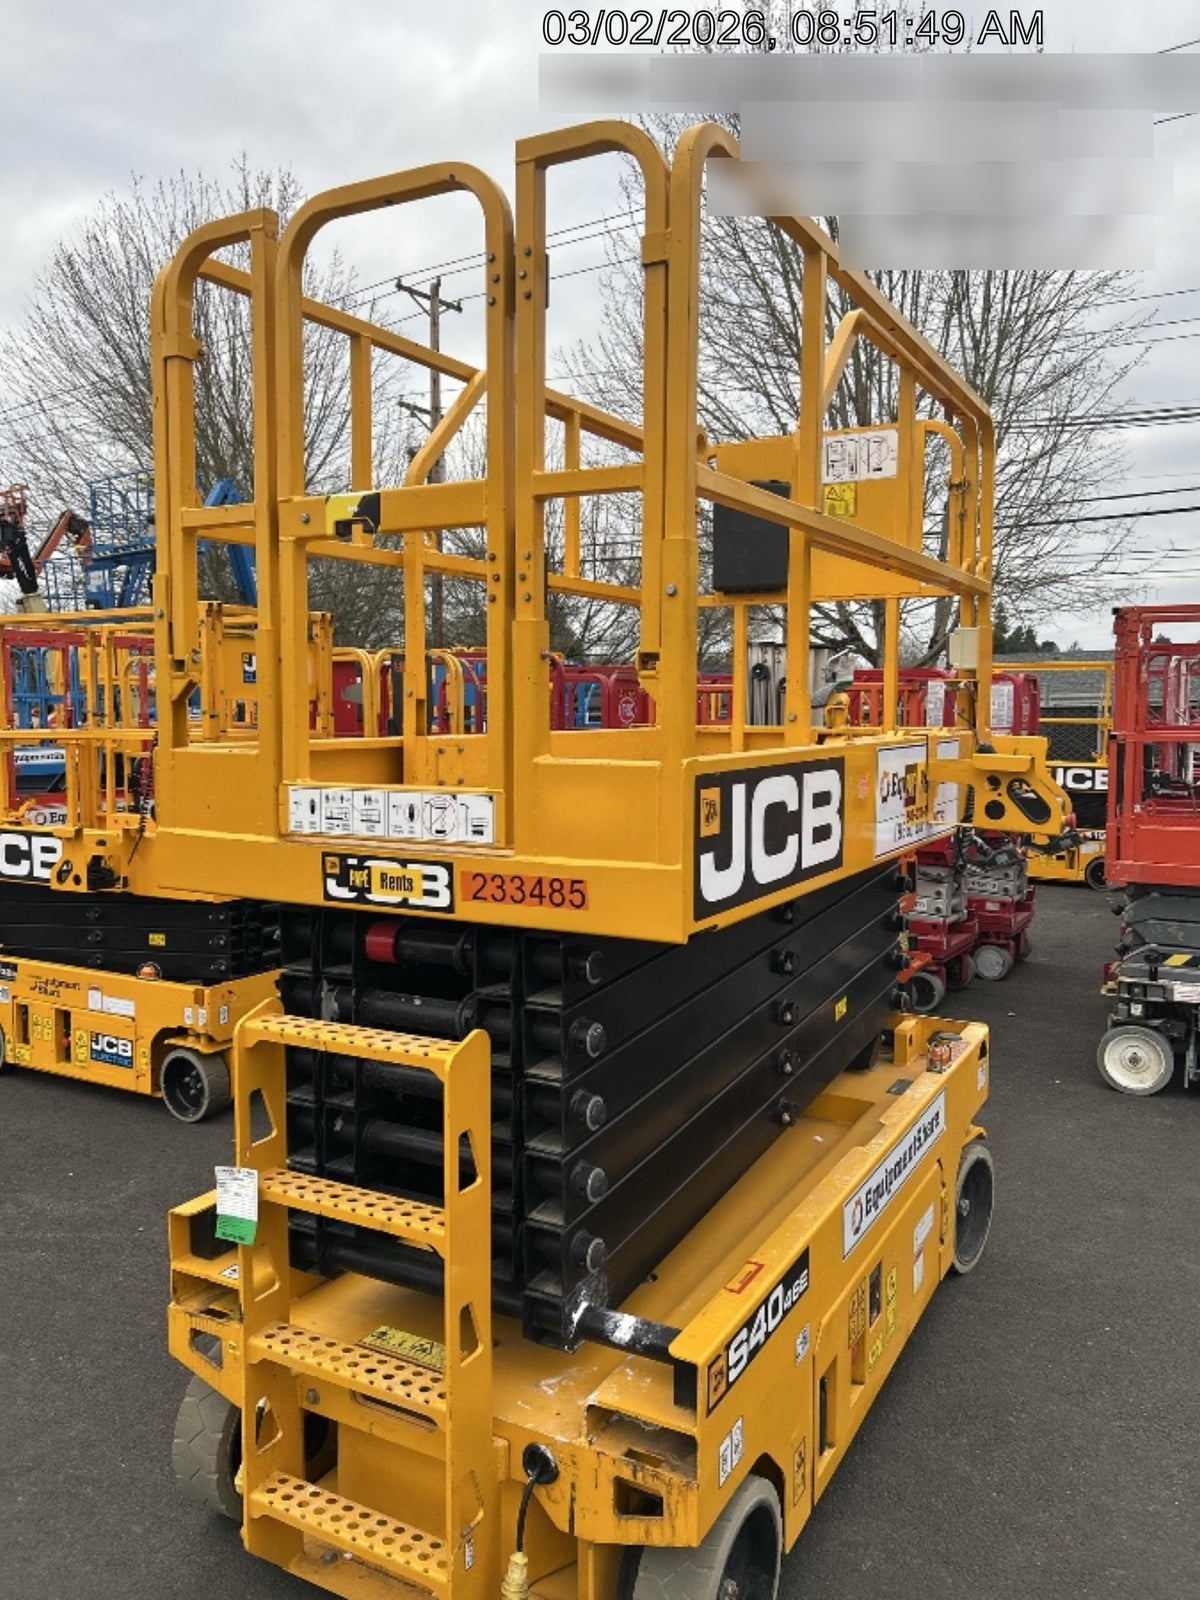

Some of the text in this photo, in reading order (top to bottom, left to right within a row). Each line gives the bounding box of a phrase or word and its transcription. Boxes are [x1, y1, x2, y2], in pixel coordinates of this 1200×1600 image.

[0, 833, 63, 879] CB
[700, 769, 842, 902] JCB
[380, 872, 413, 892] Rents
[472, 873, 586, 909] 233485
[92, 1034, 132, 1056] JCB
[865, 1110, 940, 1217] EquipmentShare
